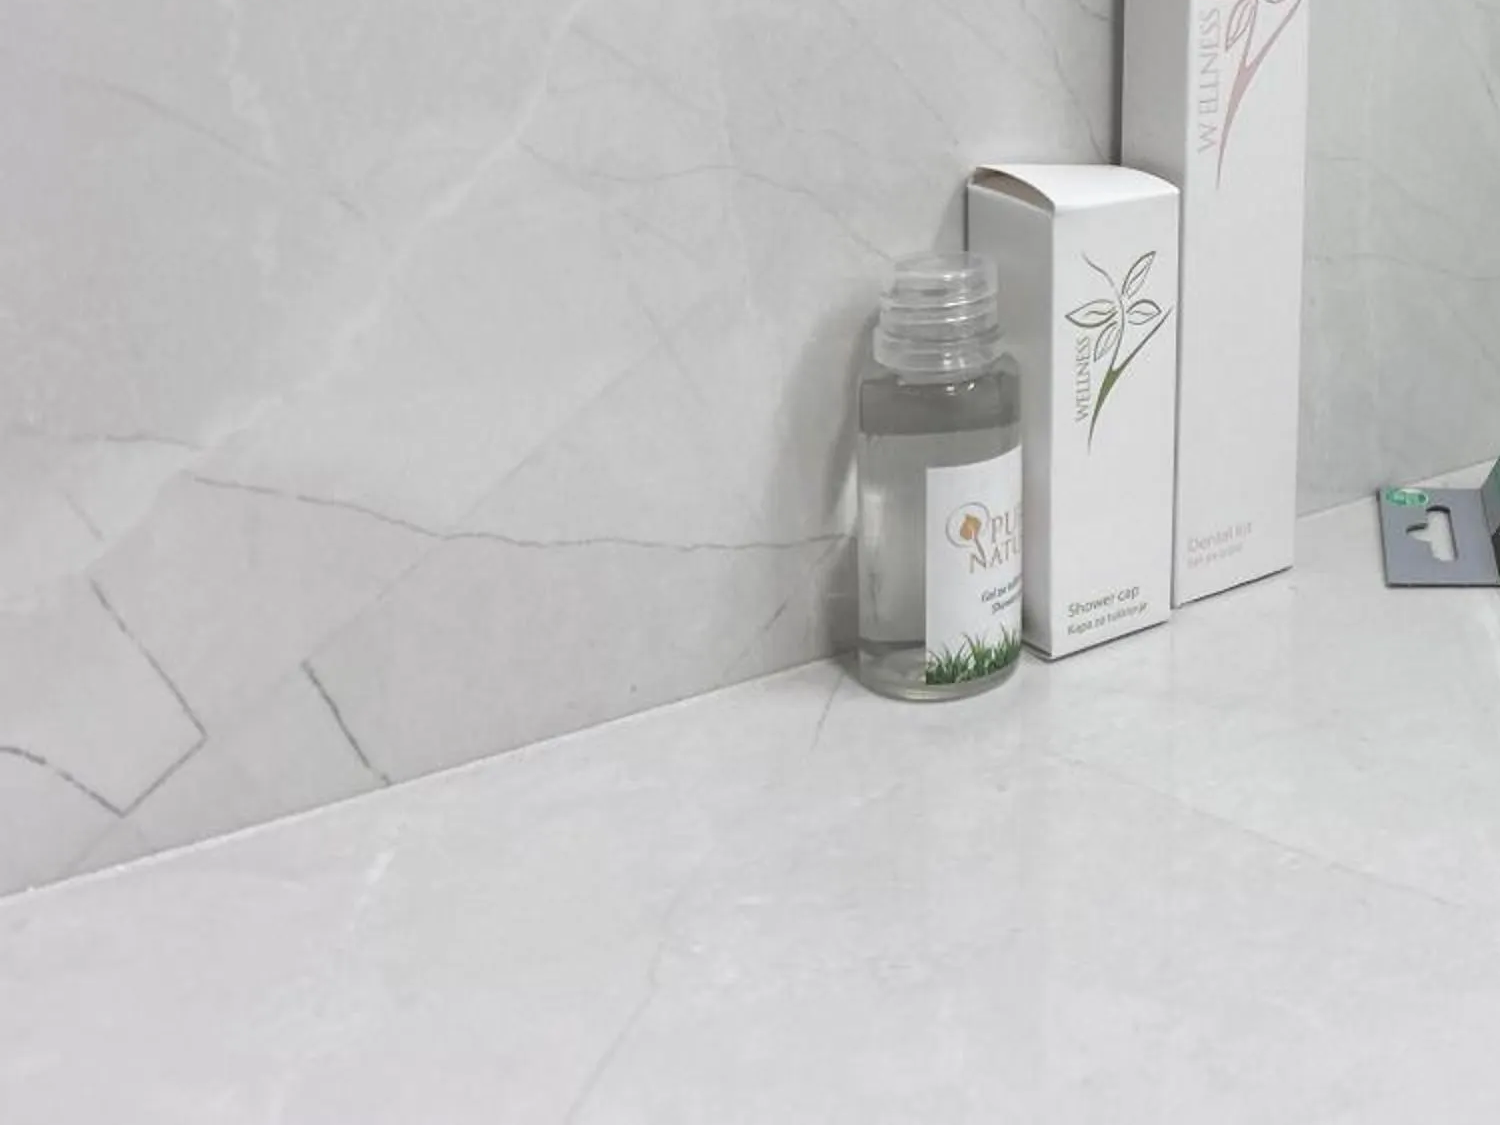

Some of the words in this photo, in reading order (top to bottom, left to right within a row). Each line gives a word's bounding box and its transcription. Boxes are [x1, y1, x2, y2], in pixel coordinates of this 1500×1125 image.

[1197, 7, 1222, 155] WELLNESS
[1074, 335, 1092, 424] WELLNESS
[990, 503, 1021, 544] PU
[1067, 592, 1115, 619] Shower
[1117, 585, 1140, 603] cap
